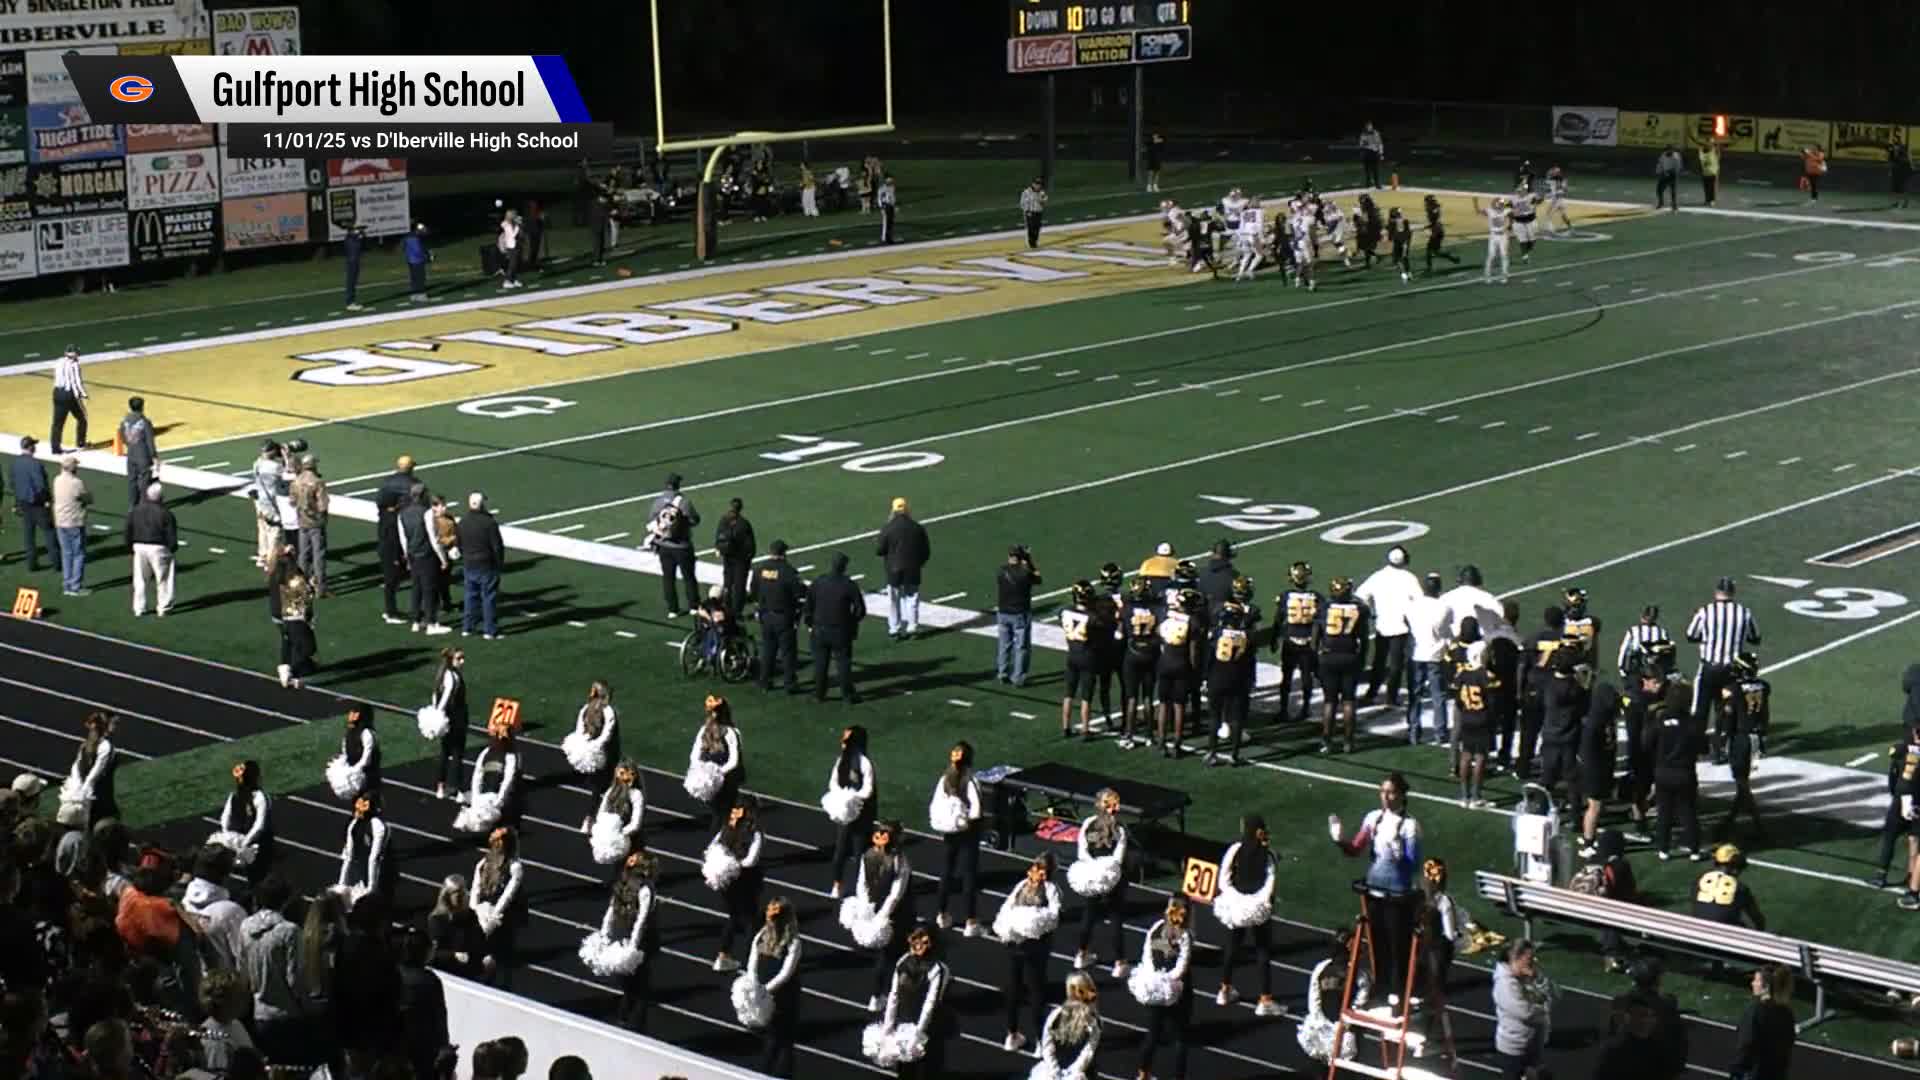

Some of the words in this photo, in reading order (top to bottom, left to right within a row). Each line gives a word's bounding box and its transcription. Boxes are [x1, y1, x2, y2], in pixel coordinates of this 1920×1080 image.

[1027, 10, 1058, 30] DOWN
[1067, 6, 1083, 31] 10
[1085, 8, 1097, 25] TO
[1101, 7, 1115, 25] GO
[1080, 48, 1128, 62] NATION
[39, 129, 78, 148] HIGH
[80, 124, 115, 141] TIDE
[60, 170, 125, 194] MORGAN
[144, 171, 217, 195] PIZZA
[65, 219, 97, 236] NEW
[165, 221, 212, 235] FAMILY
[15, 593, 34, 615] 10
[1326, 607, 1360, 635] 57
[1215, 633, 1247, 662] 87
[491, 703, 514, 726] 20
[1186, 863, 1214, 896] 30
